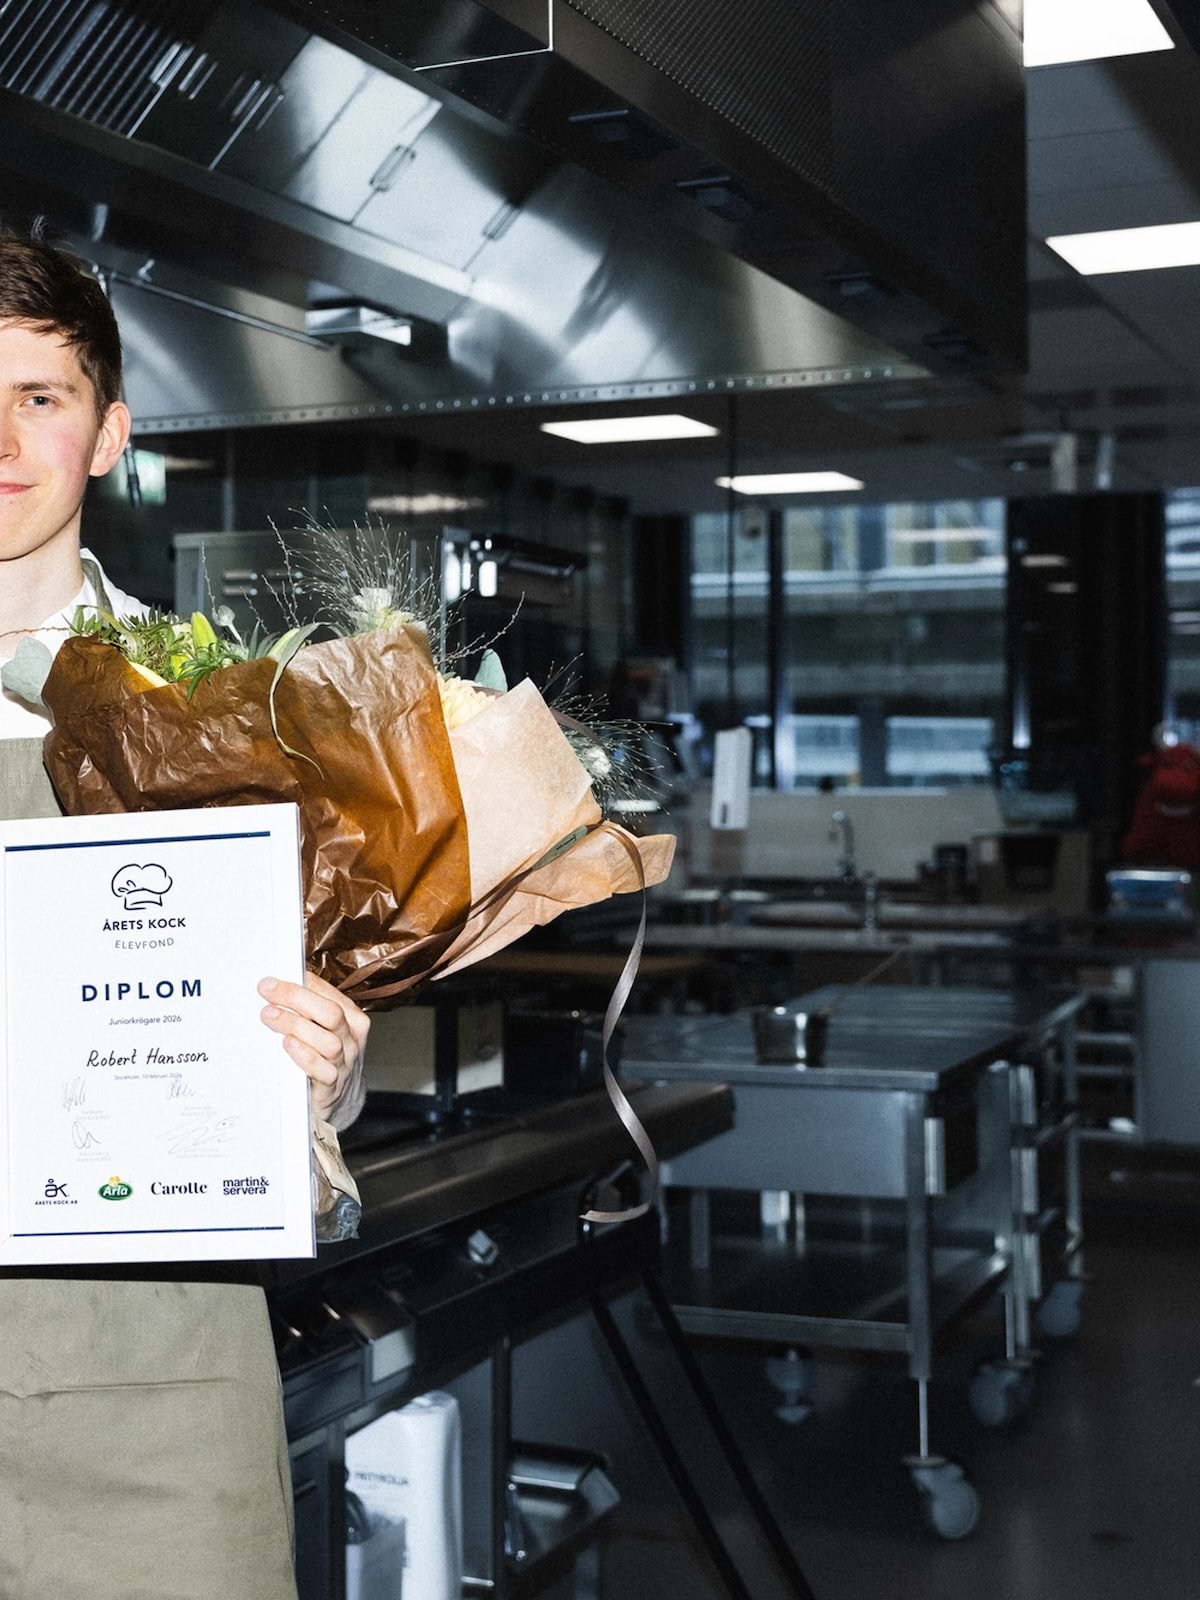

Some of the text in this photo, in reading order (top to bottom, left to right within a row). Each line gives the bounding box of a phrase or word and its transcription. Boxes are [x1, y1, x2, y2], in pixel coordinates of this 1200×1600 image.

[102, 917, 186, 932] ÅRETS KOCK
[114, 937, 175, 950] ELEVFOND
[82, 980, 203, 1002] DIPLOM
[108, 1015, 182, 1026] Juniorkrögare 2026
[86, 1048, 209, 1067] Robert Hansson
[150, 1181, 208, 1196] Carotte
[223, 1176, 270, 1188] martin&
[102, 1186, 128, 1198] Arla
[223, 1186, 267, 1196] servera
